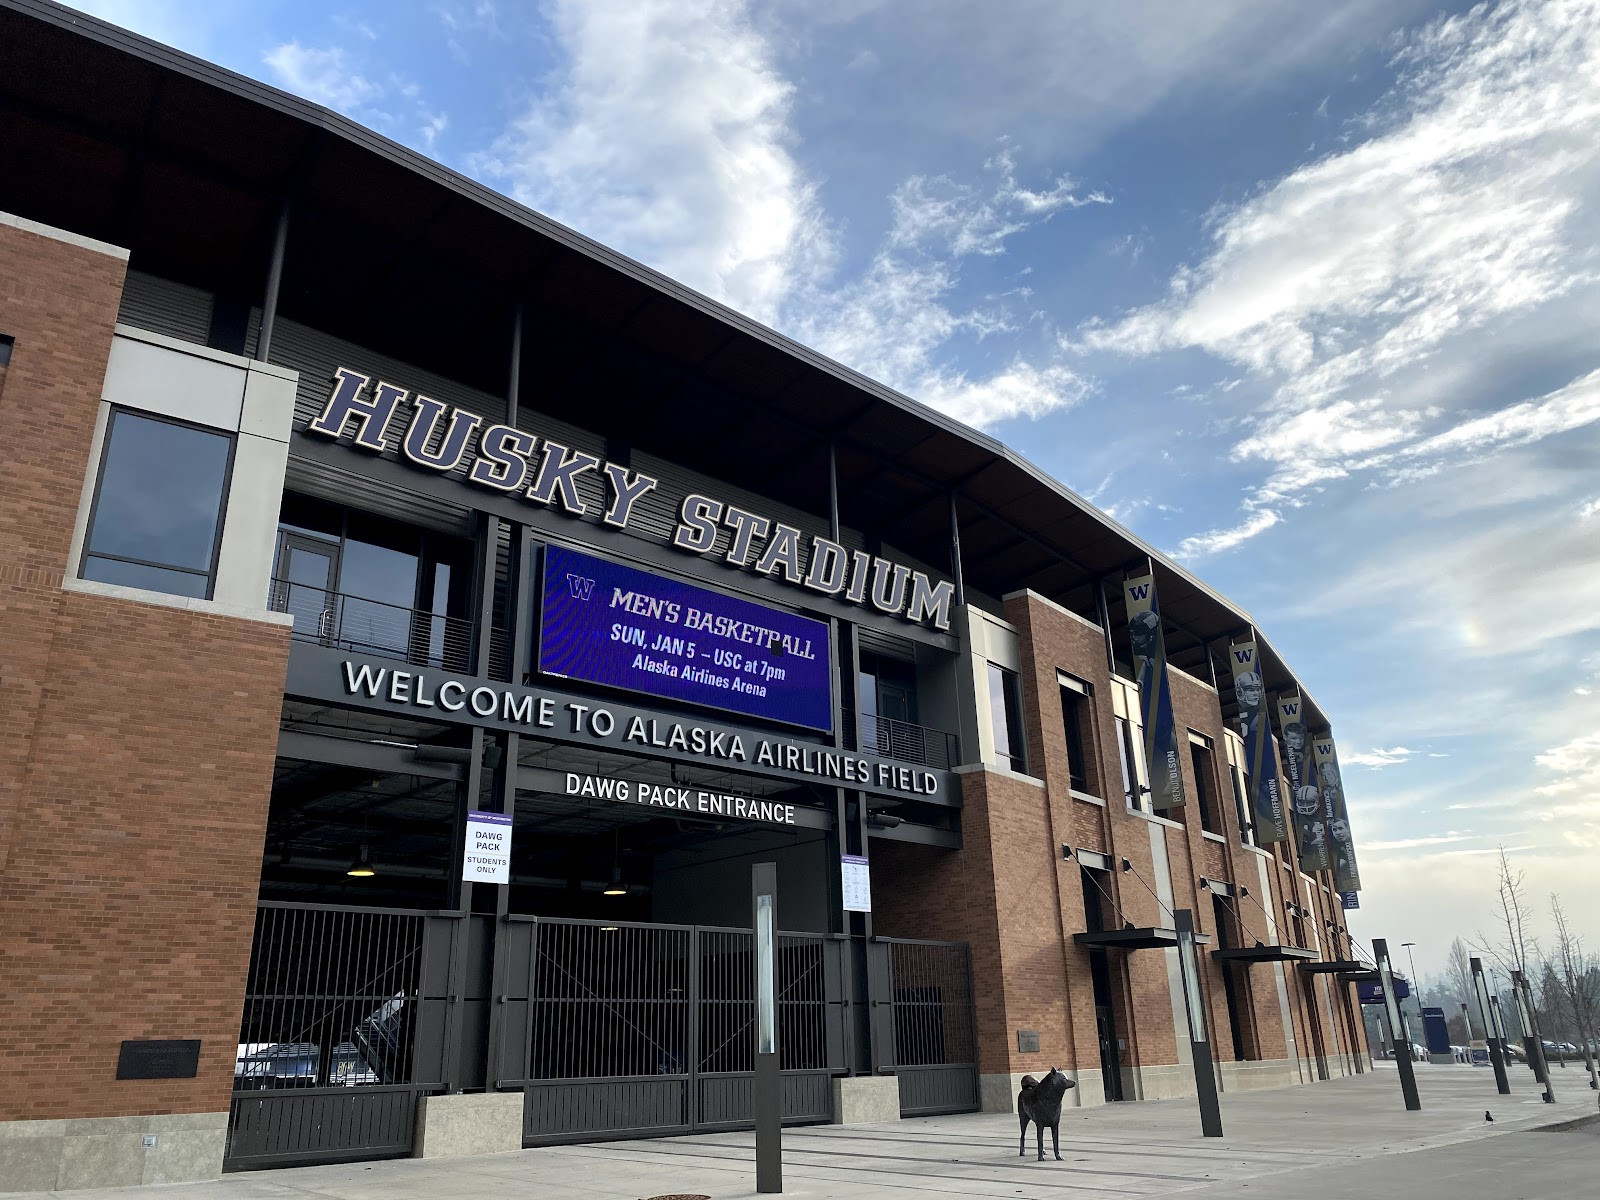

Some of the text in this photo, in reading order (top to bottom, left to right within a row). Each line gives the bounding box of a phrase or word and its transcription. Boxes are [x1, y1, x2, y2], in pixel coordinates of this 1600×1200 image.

[310, 366, 955, 631] HUSKY STADIUM
[567, 573, 595, 601] W
[1129, 583, 1150, 602] W
[609, 587, 681, 624] MEN'S
[610, 623, 648, 650] SUN,
[652, 634, 685, 657] JAN
[686, 641, 696, 659] 5
[713, 648, 743, 670] USC
[744, 658, 758, 675] at
[760, 661, 786, 682] 7pm
[1234, 648, 1253, 664] W
[632, 654, 767, 698] Alaska Airlines Arena
[1281, 702, 1299, 716] W
[345, 661, 938, 796] WELCOME TO ALASKA AIRLINES FIELD
[1316, 744, 1332, 756] W
[1166, 750, 1178, 779] OLSON
[565, 773, 795, 824] DAWG PACK ENTRANCE
[1268, 778, 1284, 838] DAVE HOFFMANN
[476, 831, 503, 841] DAWG
[476, 842, 500, 851] PACK
[467, 856, 507, 866] STUDENTS
[476, 866, 497, 874] ONLY
